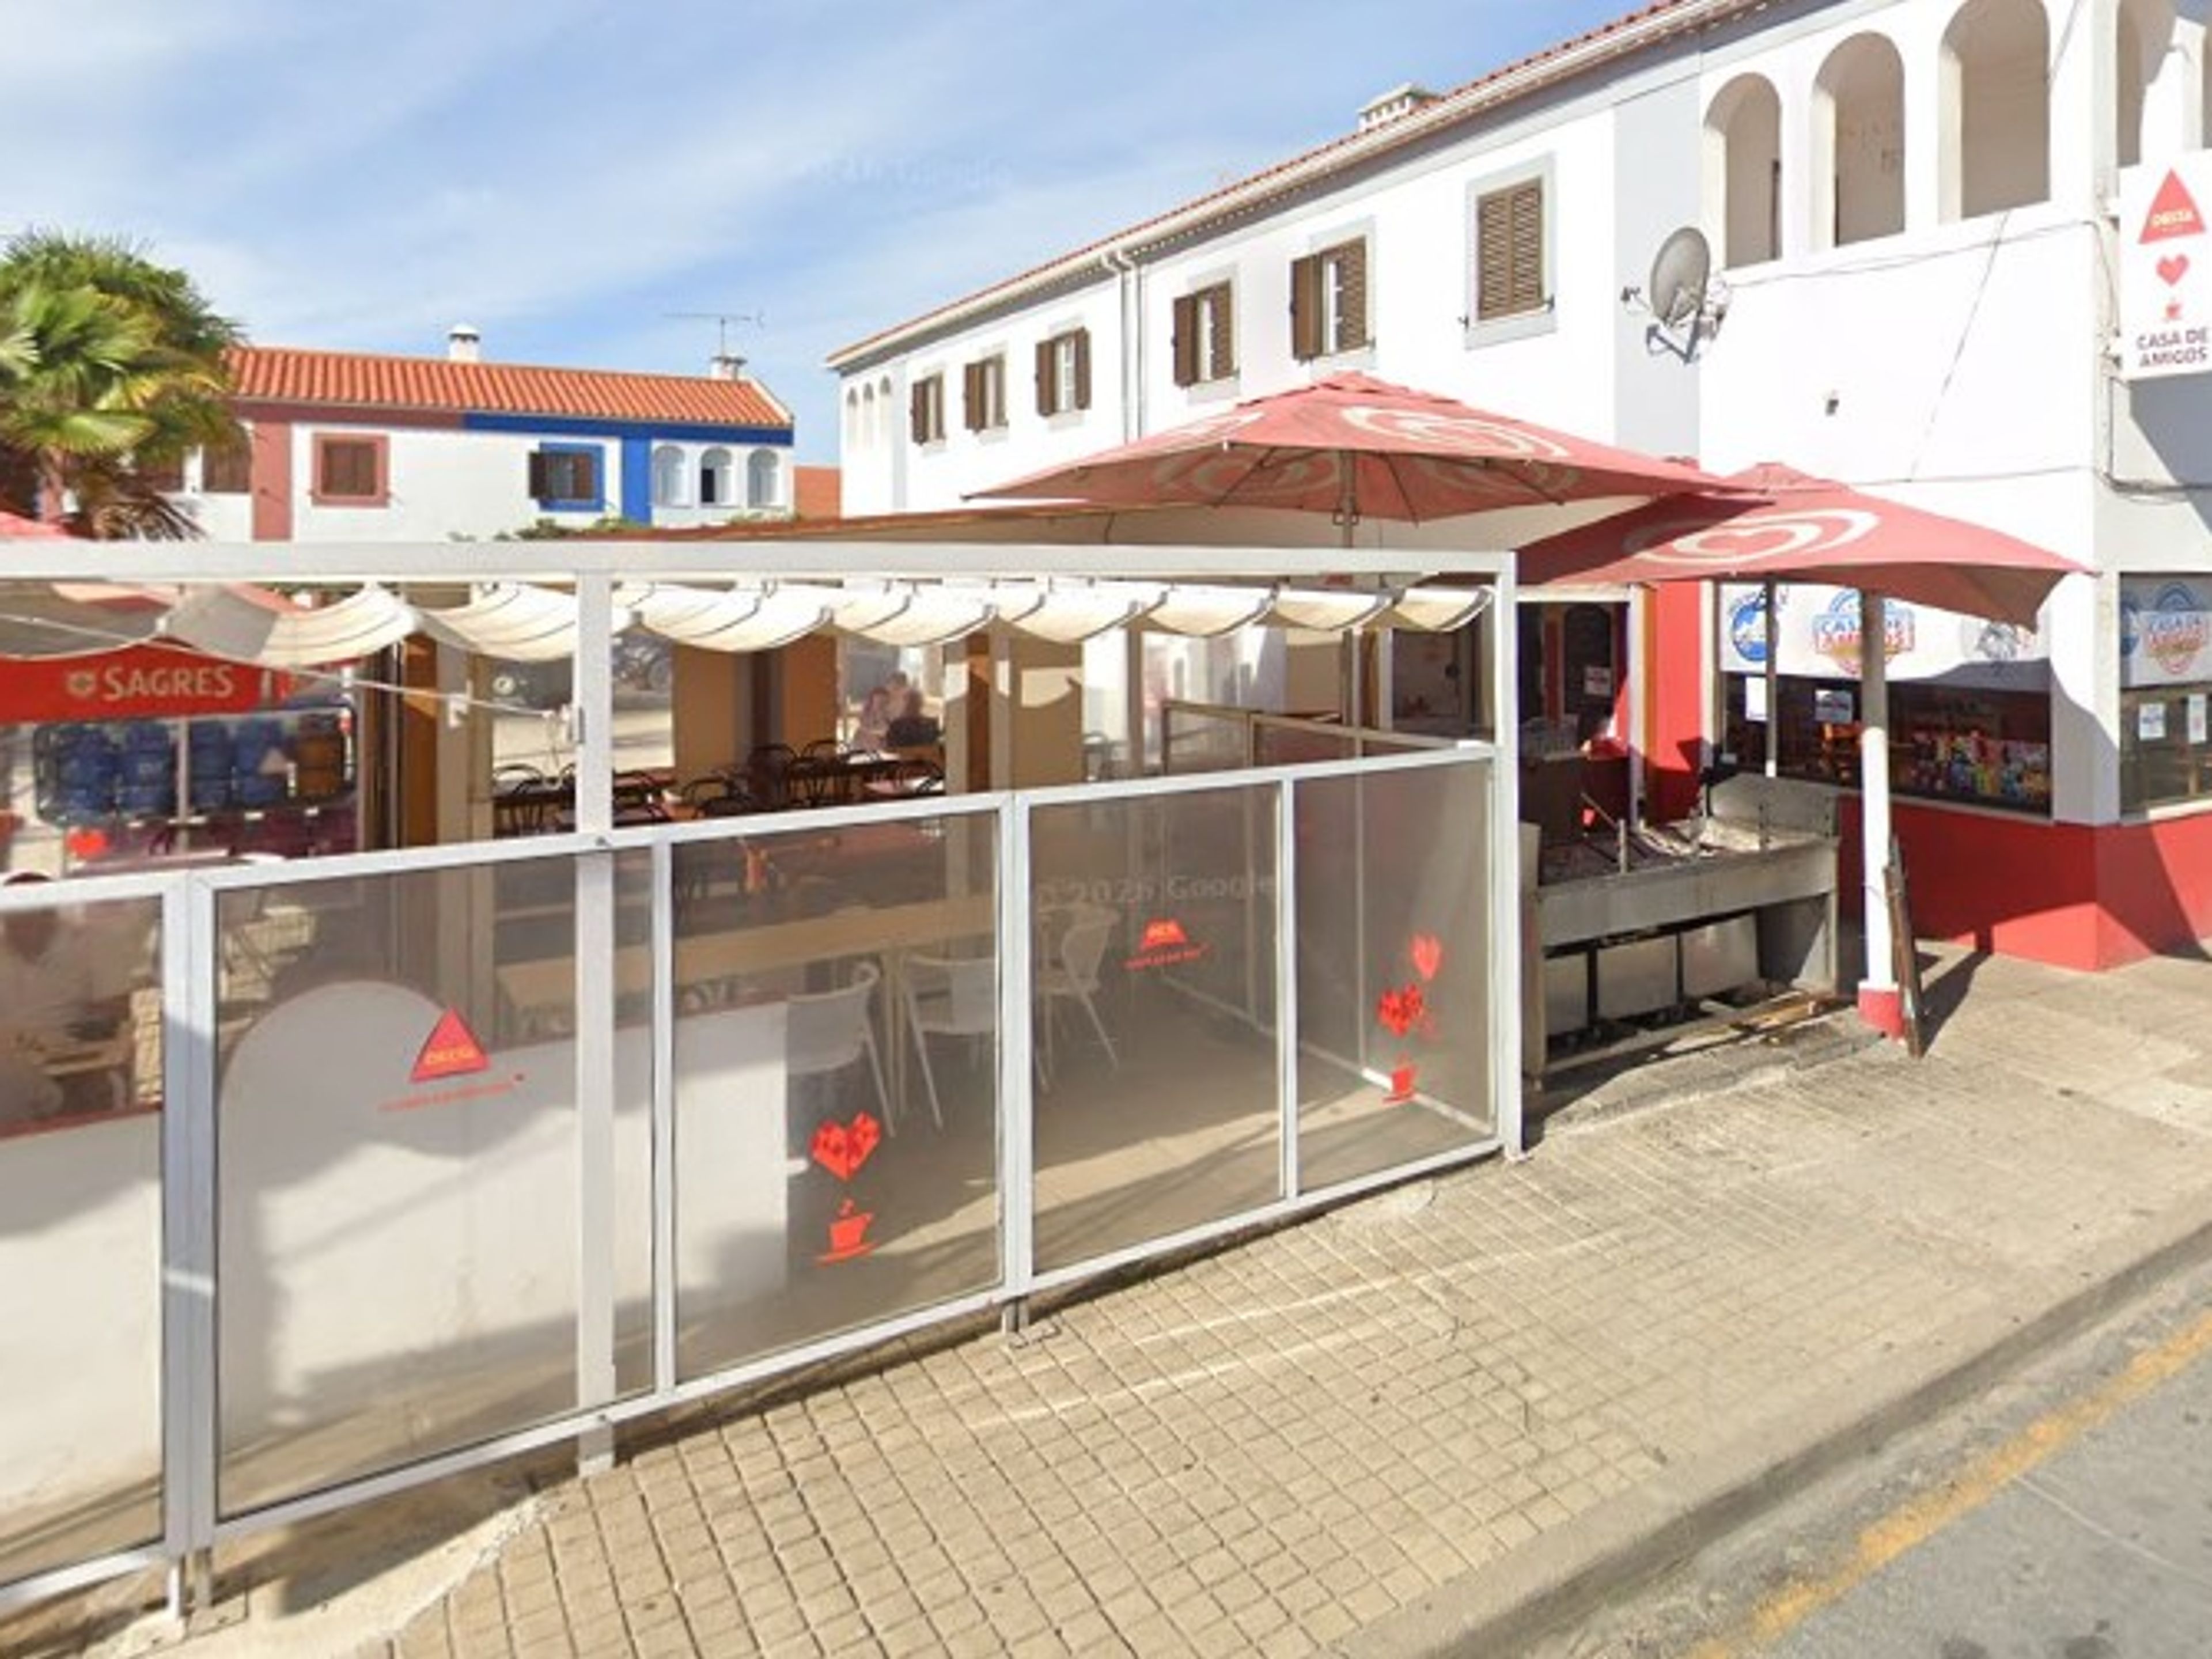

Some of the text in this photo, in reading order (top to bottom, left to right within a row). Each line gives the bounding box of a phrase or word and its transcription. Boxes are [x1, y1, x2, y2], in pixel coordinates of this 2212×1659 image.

[2136, 326, 2208, 350] CASA DE
[2139, 346, 2208, 368] AMIGOS
[104, 665, 233, 701] SAGRES
